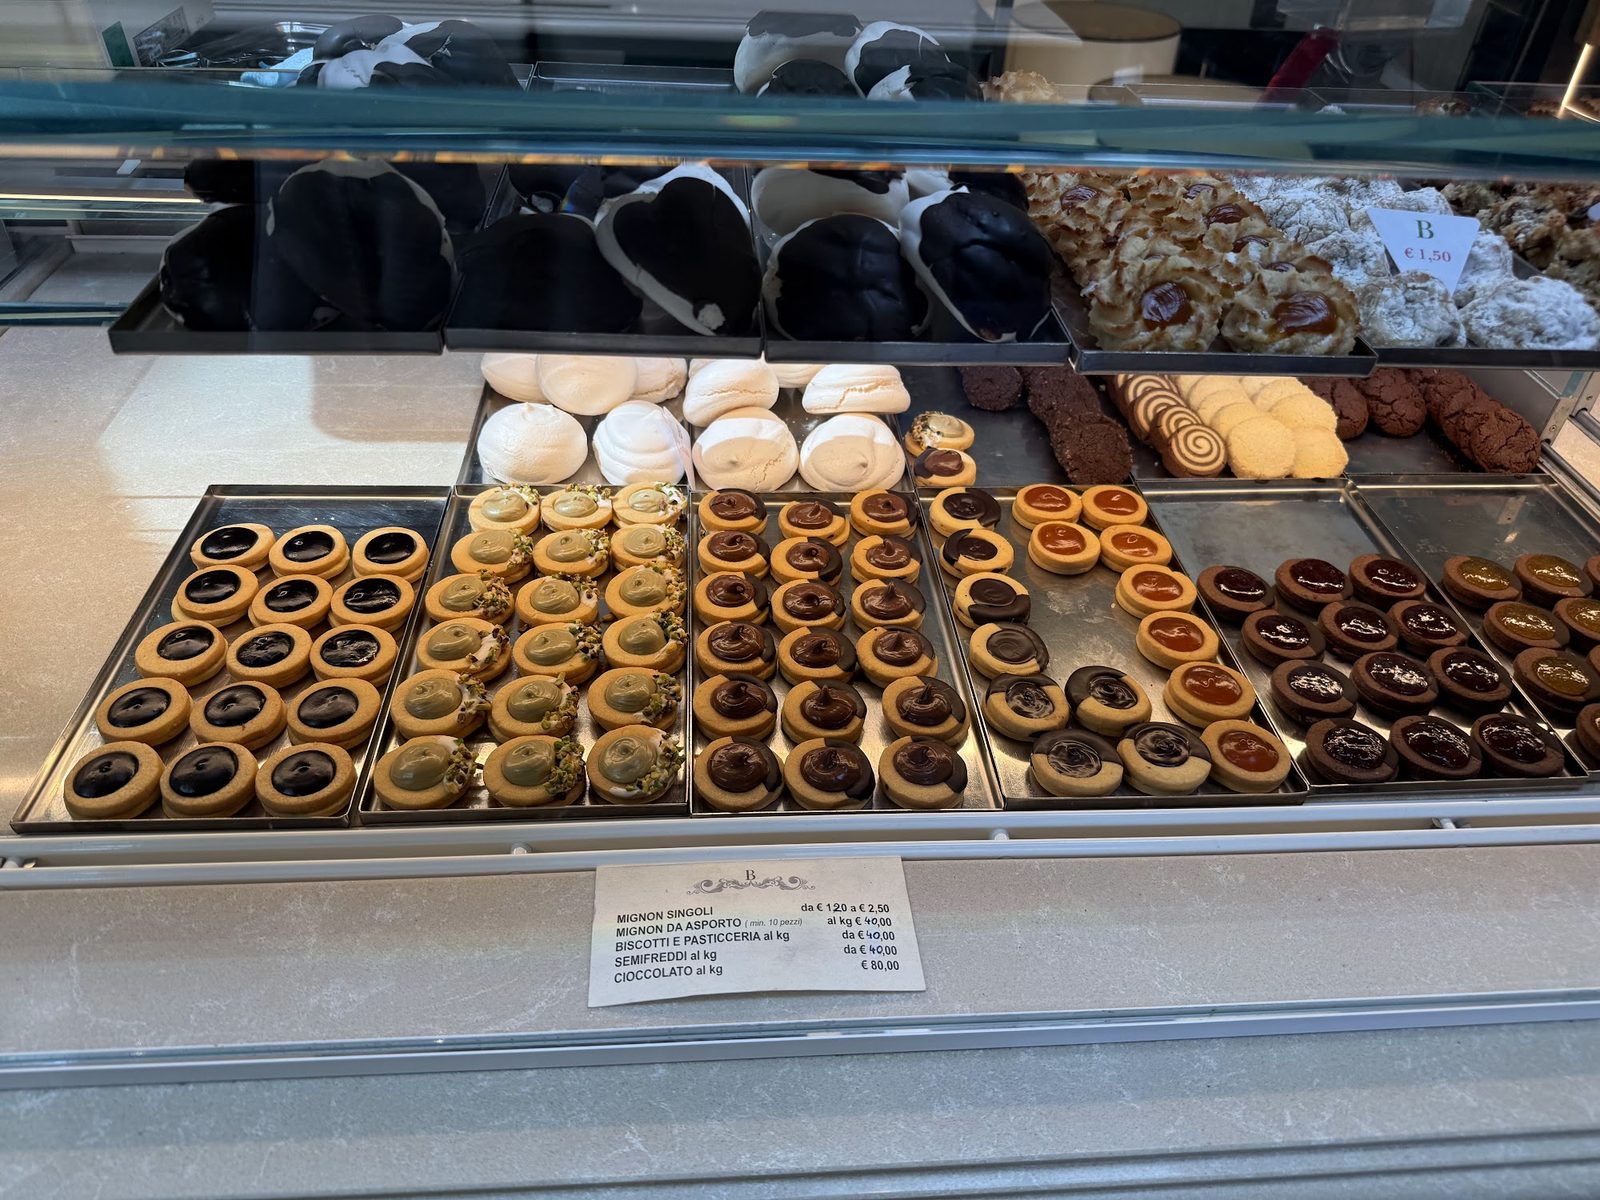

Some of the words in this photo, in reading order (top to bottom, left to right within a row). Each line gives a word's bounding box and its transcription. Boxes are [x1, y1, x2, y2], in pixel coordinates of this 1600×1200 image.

[1416, 219, 1434, 239] B
[1404, 247, 1414, 258] €
[1419, 248, 1451, 262] 1,50
[745, 869, 756, 881] B
[616, 911, 663, 924] MIGNON
[666, 906, 713, 919] SINGOLI
[800, 903, 814, 912] da
[816, 902, 823, 912] €
[859, 903, 866, 913] €
[868, 904, 890, 915] 2,50
[615, 924, 663, 938] MIGNON
[666, 922, 683, 933] DA
[685, 918, 742, 931] ASPORTO
[768, 918, 779, 927] 10
[827, 916, 837, 925] al
[839, 916, 853, 928] kg
[855, 916, 862, 926] €
[864, 916, 892, 928] 40,00
[615, 937, 670, 952] BISCOTTI
[673, 936, 681, 947] E
[683, 931, 761, 946] PASTICCERIA
[763, 930, 773, 941] al
[776, 930, 790, 942] kg
[841, 930, 855, 940] da
[857, 930, 865, 940] €
[865, 930, 895, 942] 40,00
[614, 950, 687, 968] SEMIFREDDI
[690, 950, 700, 961] al
[703, 949, 717, 962] kg
[843, 944, 857, 955] da
[859, 944, 867, 955] €
[868, 944, 898, 957] 40,00
[614, 965, 693, 984] CIOCCOLATO
[696, 965, 706, 976] al
[709, 964, 723, 976] kg
[861, 959, 869, 970] €
[870, 959, 900, 972] 80,00
